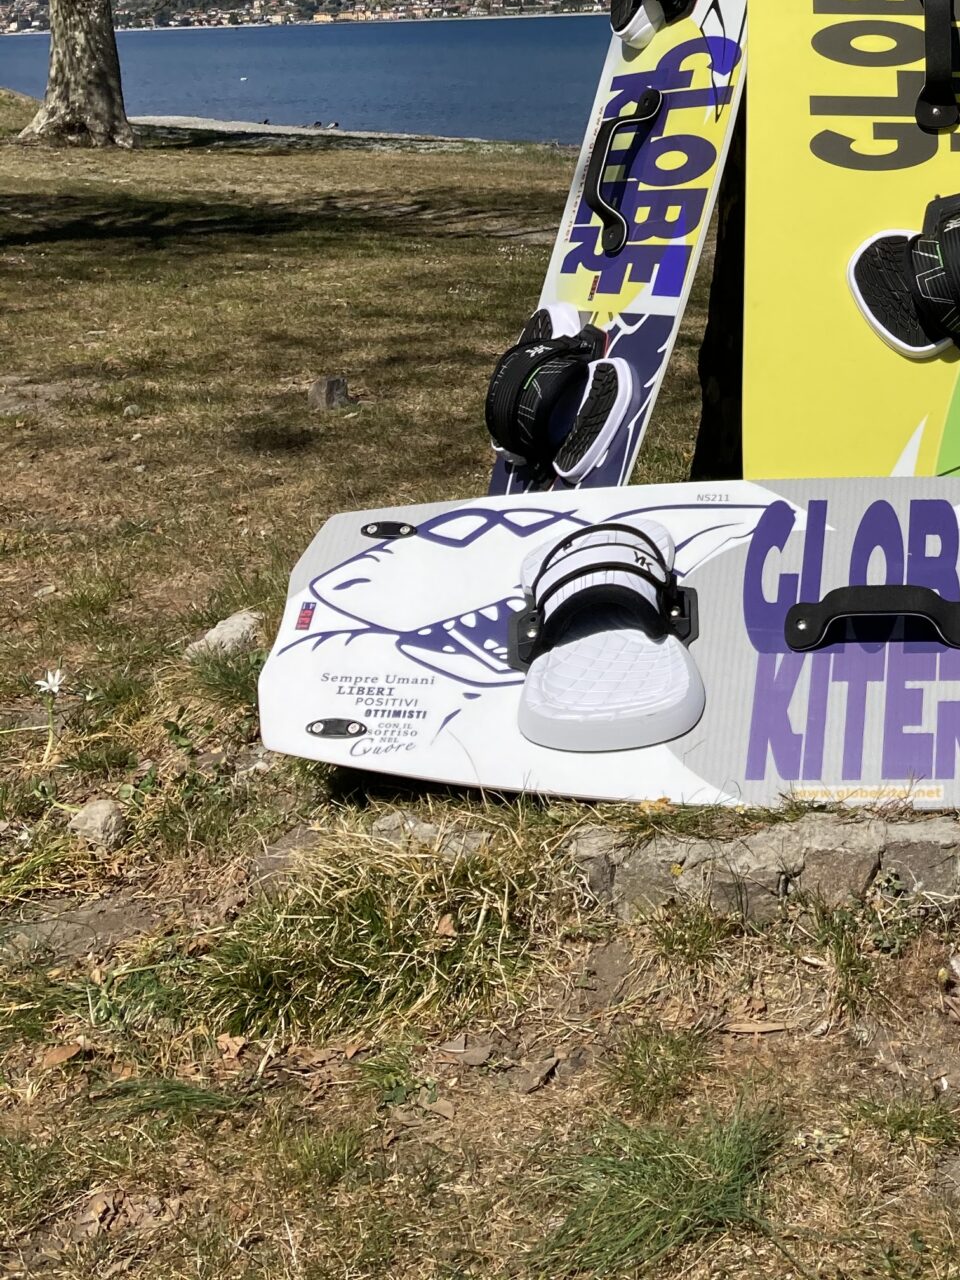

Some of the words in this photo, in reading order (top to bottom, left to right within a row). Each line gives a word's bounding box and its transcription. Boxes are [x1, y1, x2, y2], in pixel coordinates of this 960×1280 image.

[596, 35, 742, 297] GLOBE
[696, 494, 729, 502] NS211
[320, 672, 379, 686] Sempre
[385, 674, 436, 685] Umani
[336, 685, 395, 696] LIBERI
[355, 697, 418, 707] POSITIVI
[364, 708, 427, 719] OTTIMISTI
[349, 737, 417, 757] Cuore
